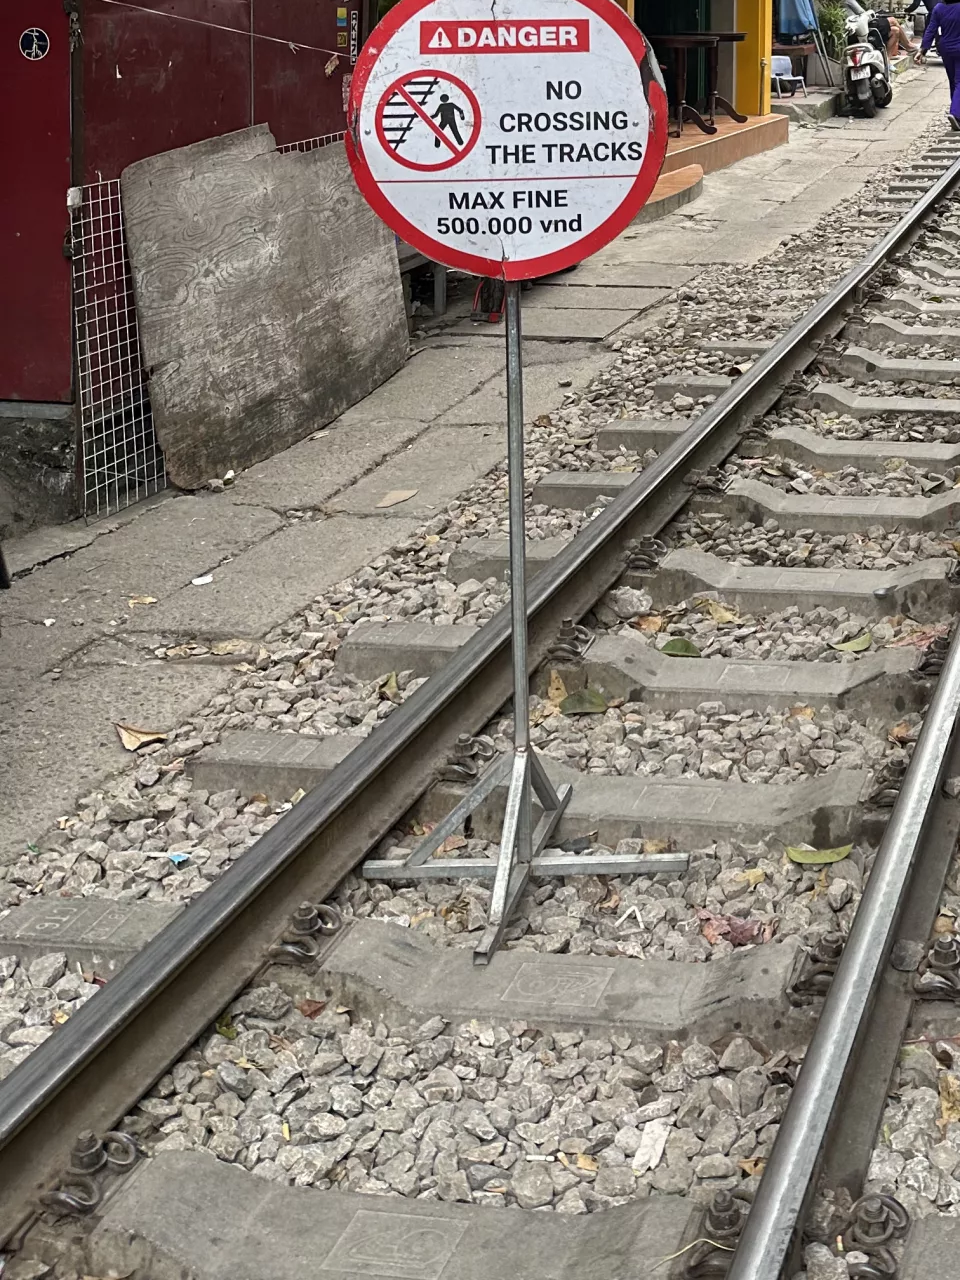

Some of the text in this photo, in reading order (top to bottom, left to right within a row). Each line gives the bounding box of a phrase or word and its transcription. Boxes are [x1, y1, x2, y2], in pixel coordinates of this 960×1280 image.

[457, 25, 577, 47] DANGER
[546, 80, 581, 100] NO
[499, 110, 628, 132] CROSSING
[484, 141, 642, 164] THE TRACKS
[448, 189, 568, 209] MAX FINE
[437, 213, 582, 235] 500.000 vnd
